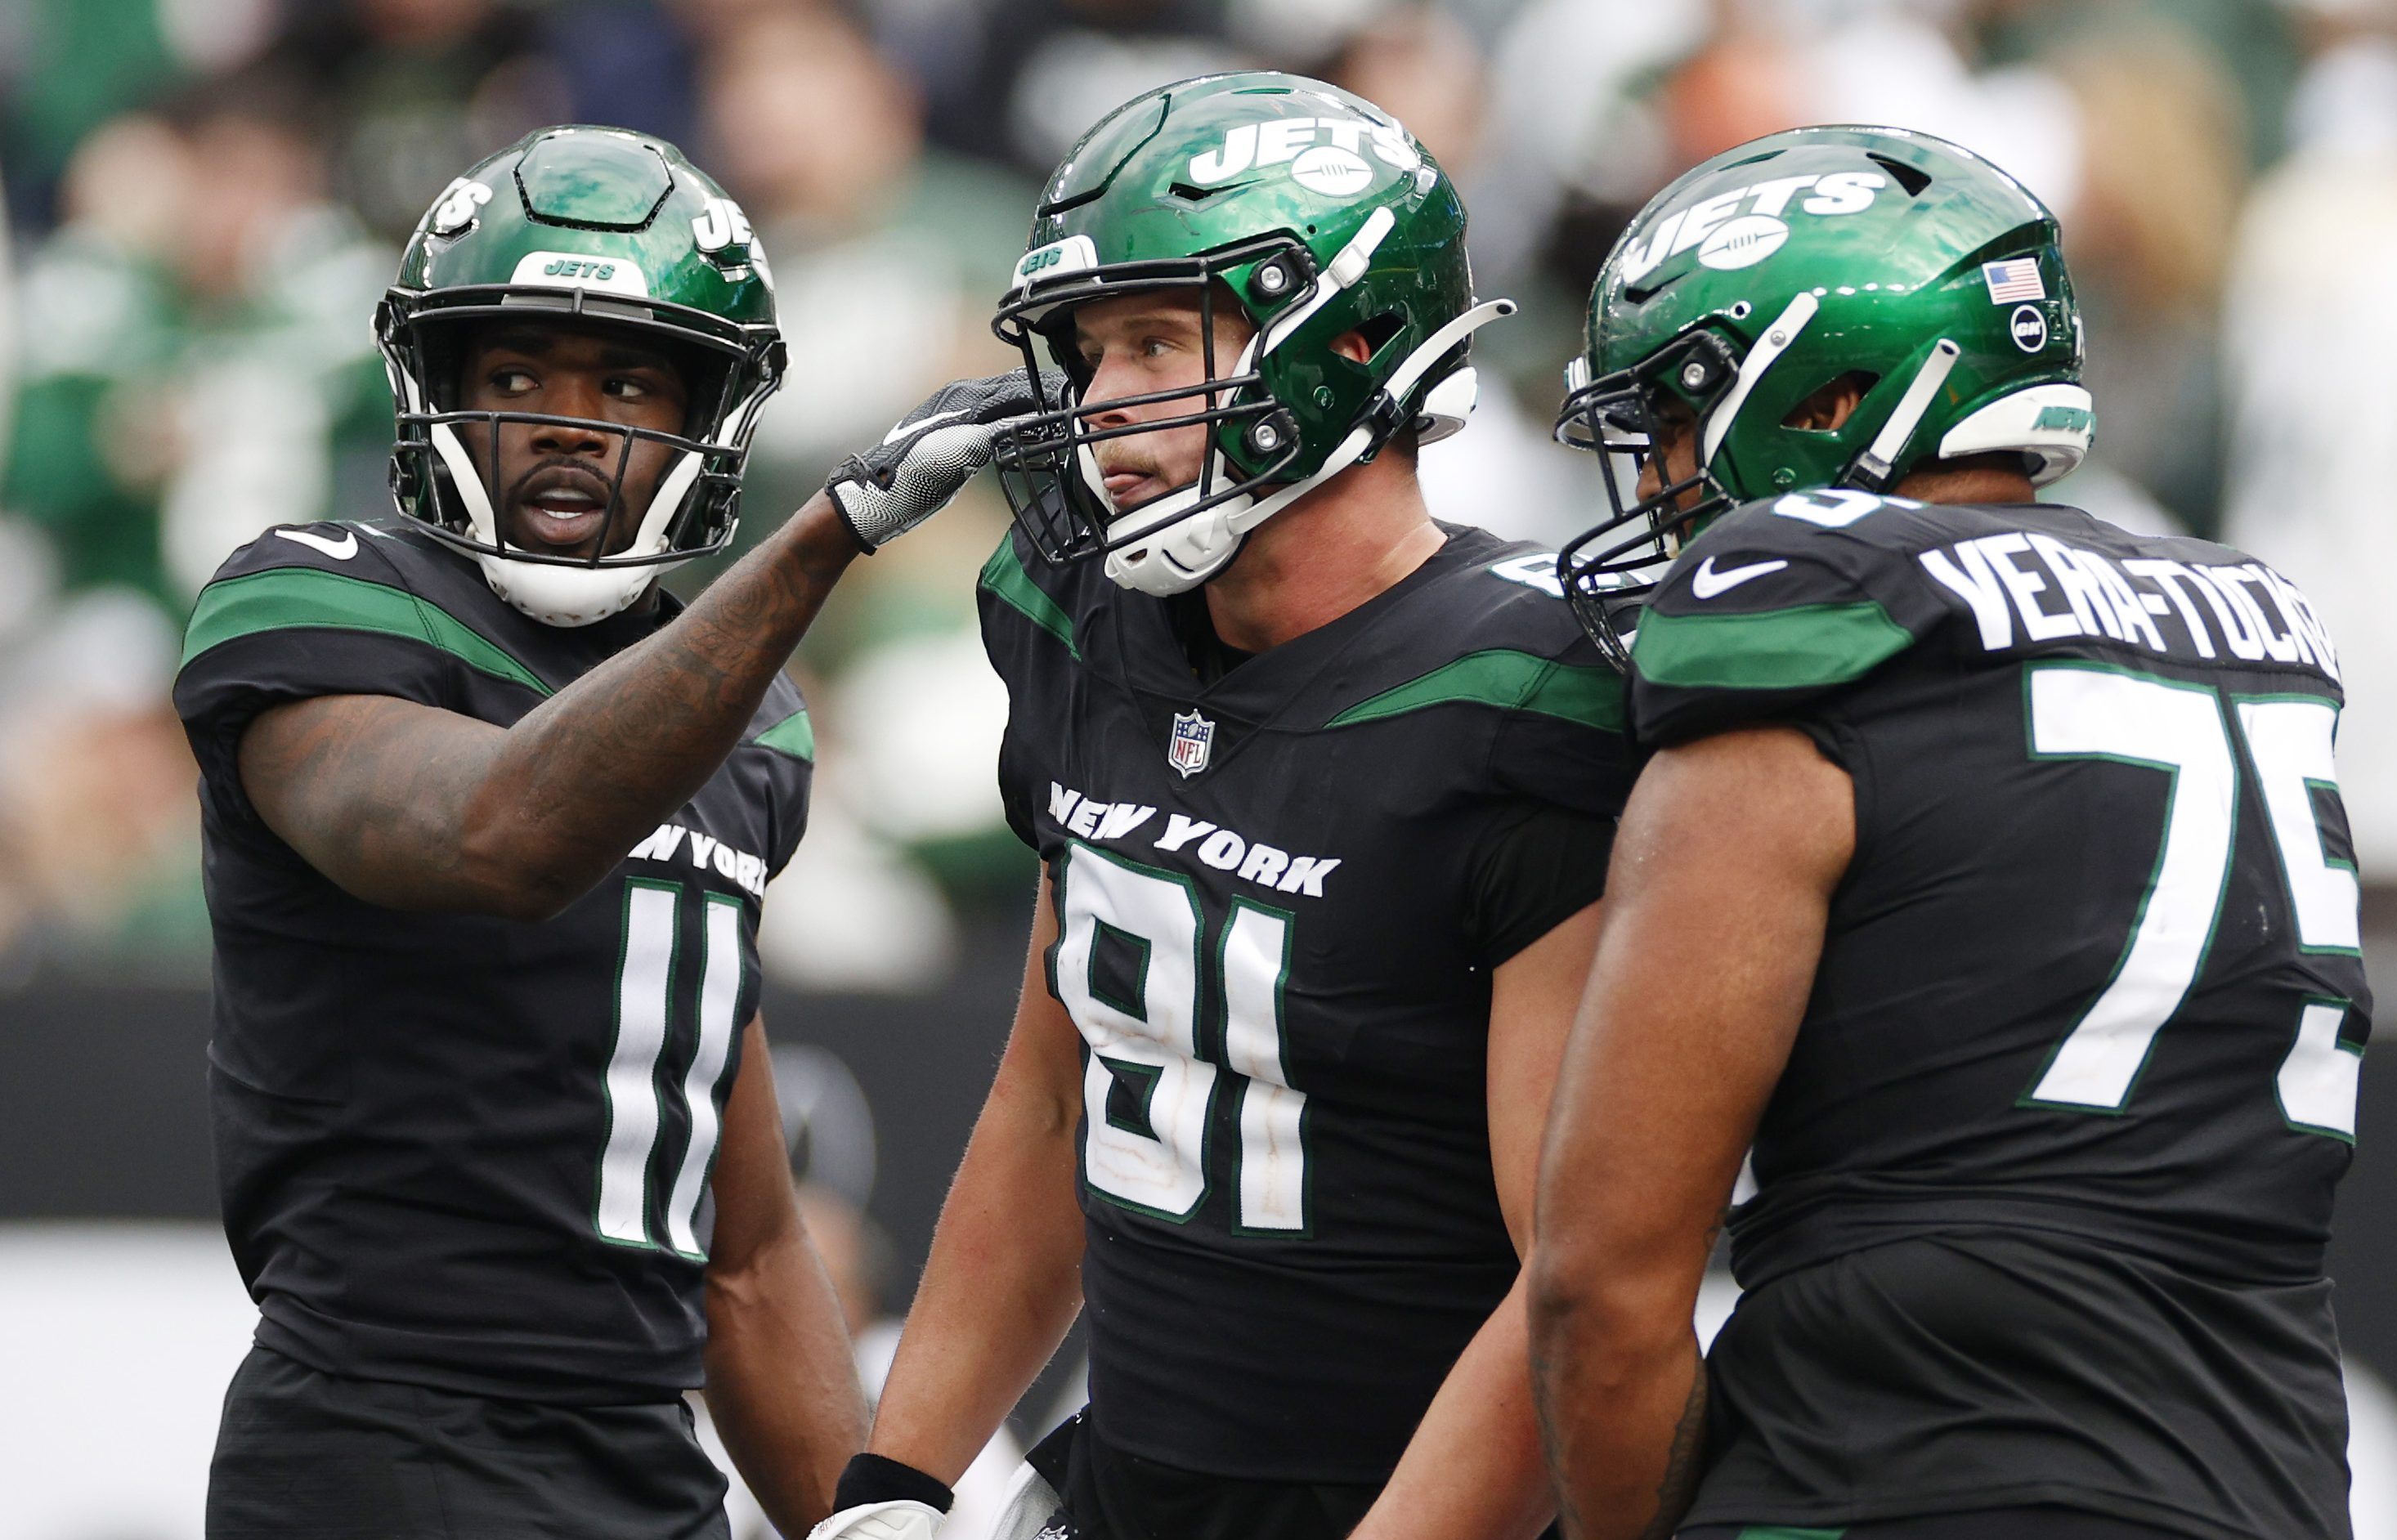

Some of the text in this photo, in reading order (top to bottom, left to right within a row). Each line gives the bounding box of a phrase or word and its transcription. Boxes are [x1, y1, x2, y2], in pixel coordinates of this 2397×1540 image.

[1189, 117, 1418, 185] JETS
[544, 258, 616, 281] JETS
[1019, 247, 1063, 275] JETS
[1623, 172, 1886, 284] JETS
[1175, 739, 1202, 766] NFL
[1048, 781, 1342, 898] NEW YORK
[2014, 659, 2363, 1146] 75
[591, 875, 746, 1264] 11
[1051, 839, 1313, 1239] 81
